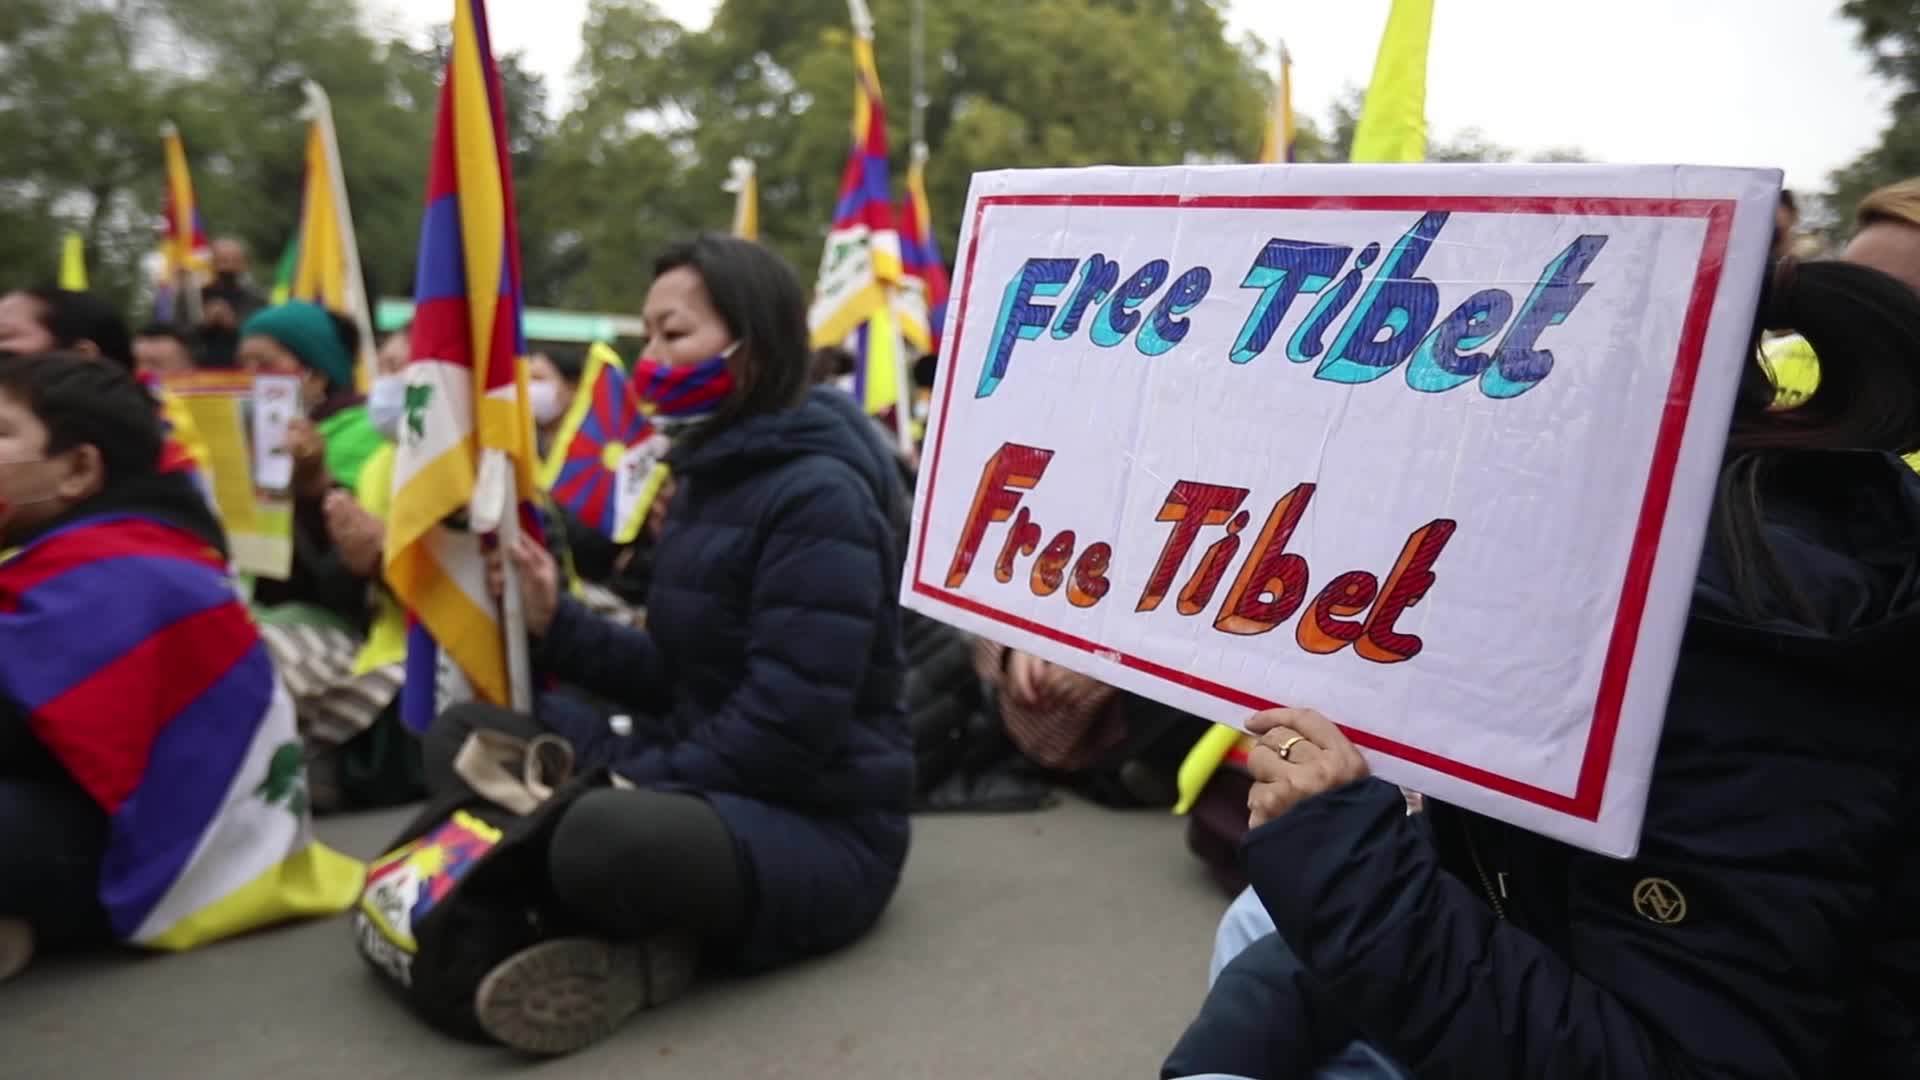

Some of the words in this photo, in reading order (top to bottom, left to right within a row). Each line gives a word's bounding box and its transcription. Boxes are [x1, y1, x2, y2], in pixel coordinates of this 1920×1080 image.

[975, 252, 1211, 399] Free
[1229, 211, 1608, 399] Tibet
[944, 441, 1111, 608] Free
[1135, 479, 1457, 664] Tibet
